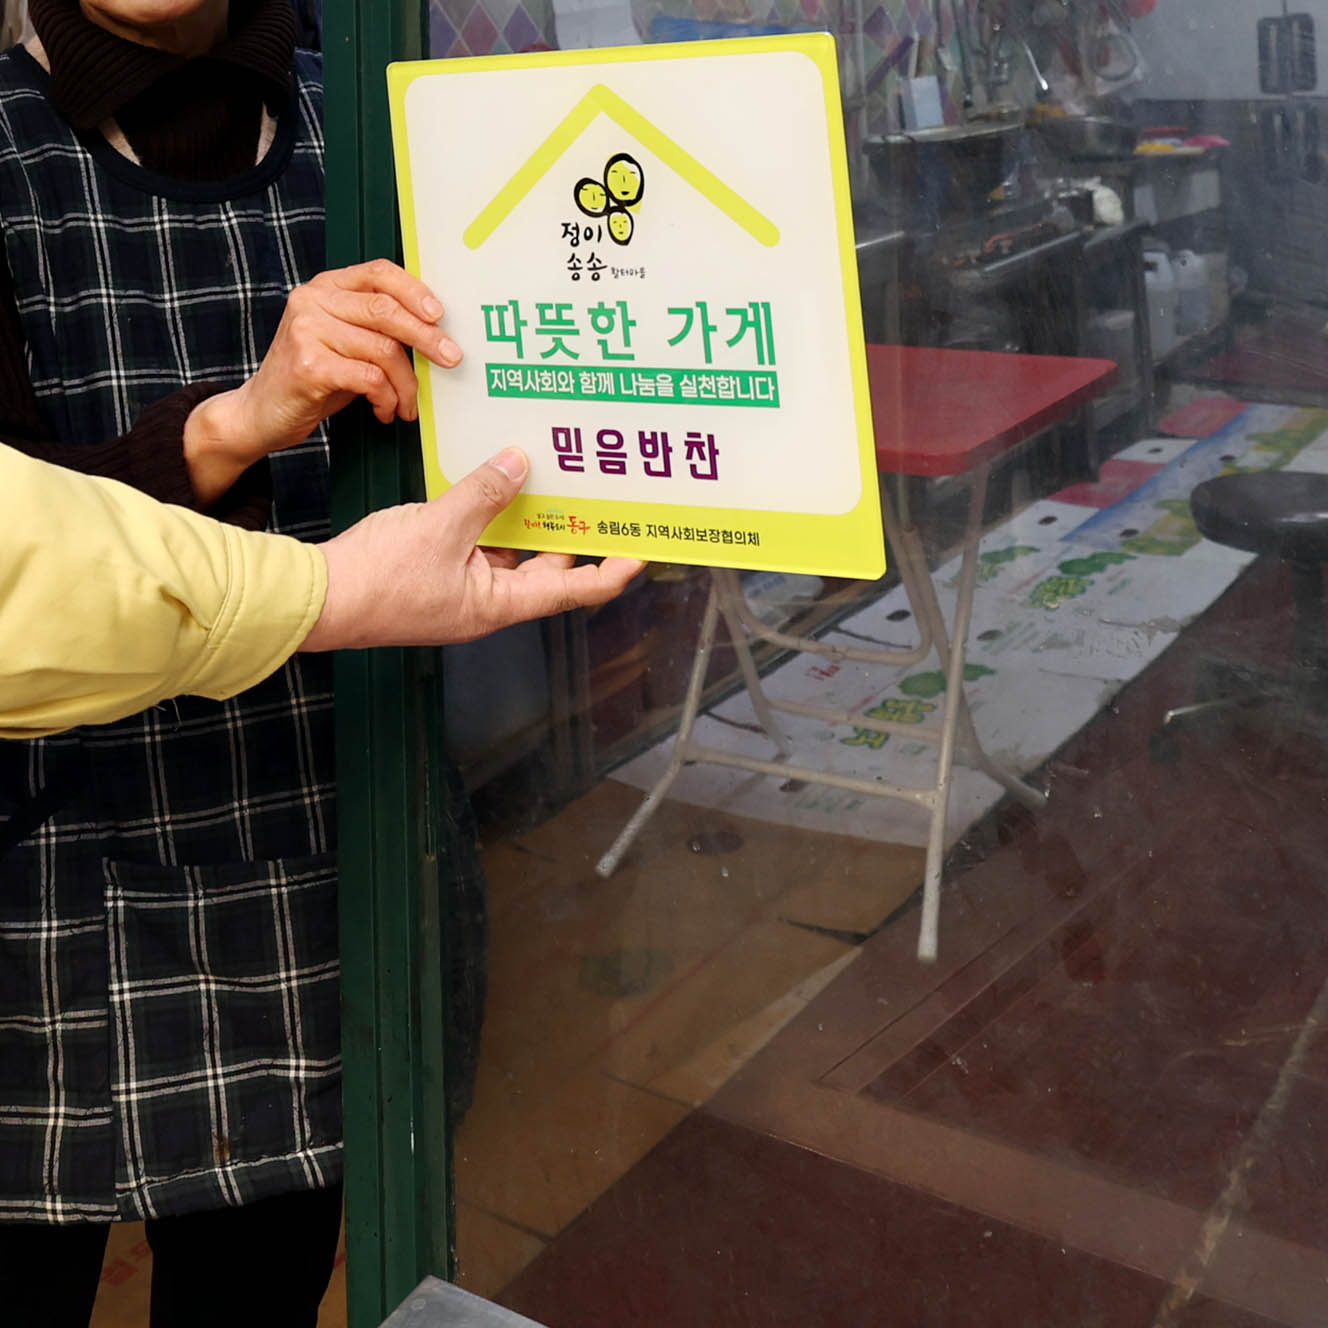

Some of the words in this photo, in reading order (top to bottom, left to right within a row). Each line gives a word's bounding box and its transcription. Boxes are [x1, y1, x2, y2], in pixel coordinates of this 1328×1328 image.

[560, 221, 603, 248] 정이
[567, 251, 608, 282] 송송
[481, 299, 637, 362] 따뜻한
[667, 300, 777, 366] 가게
[489, 368, 576, 394] 지역사회와
[579, 371, 616, 396] 함께
[619, 373, 674, 399] 나눔을
[679, 374, 776, 402] 실천합니다
[551, 426, 721, 481] 믿음반찬
[597, 519, 643, 538] 송림6동
[646, 523, 761, 548] 지역사회보장협의체
